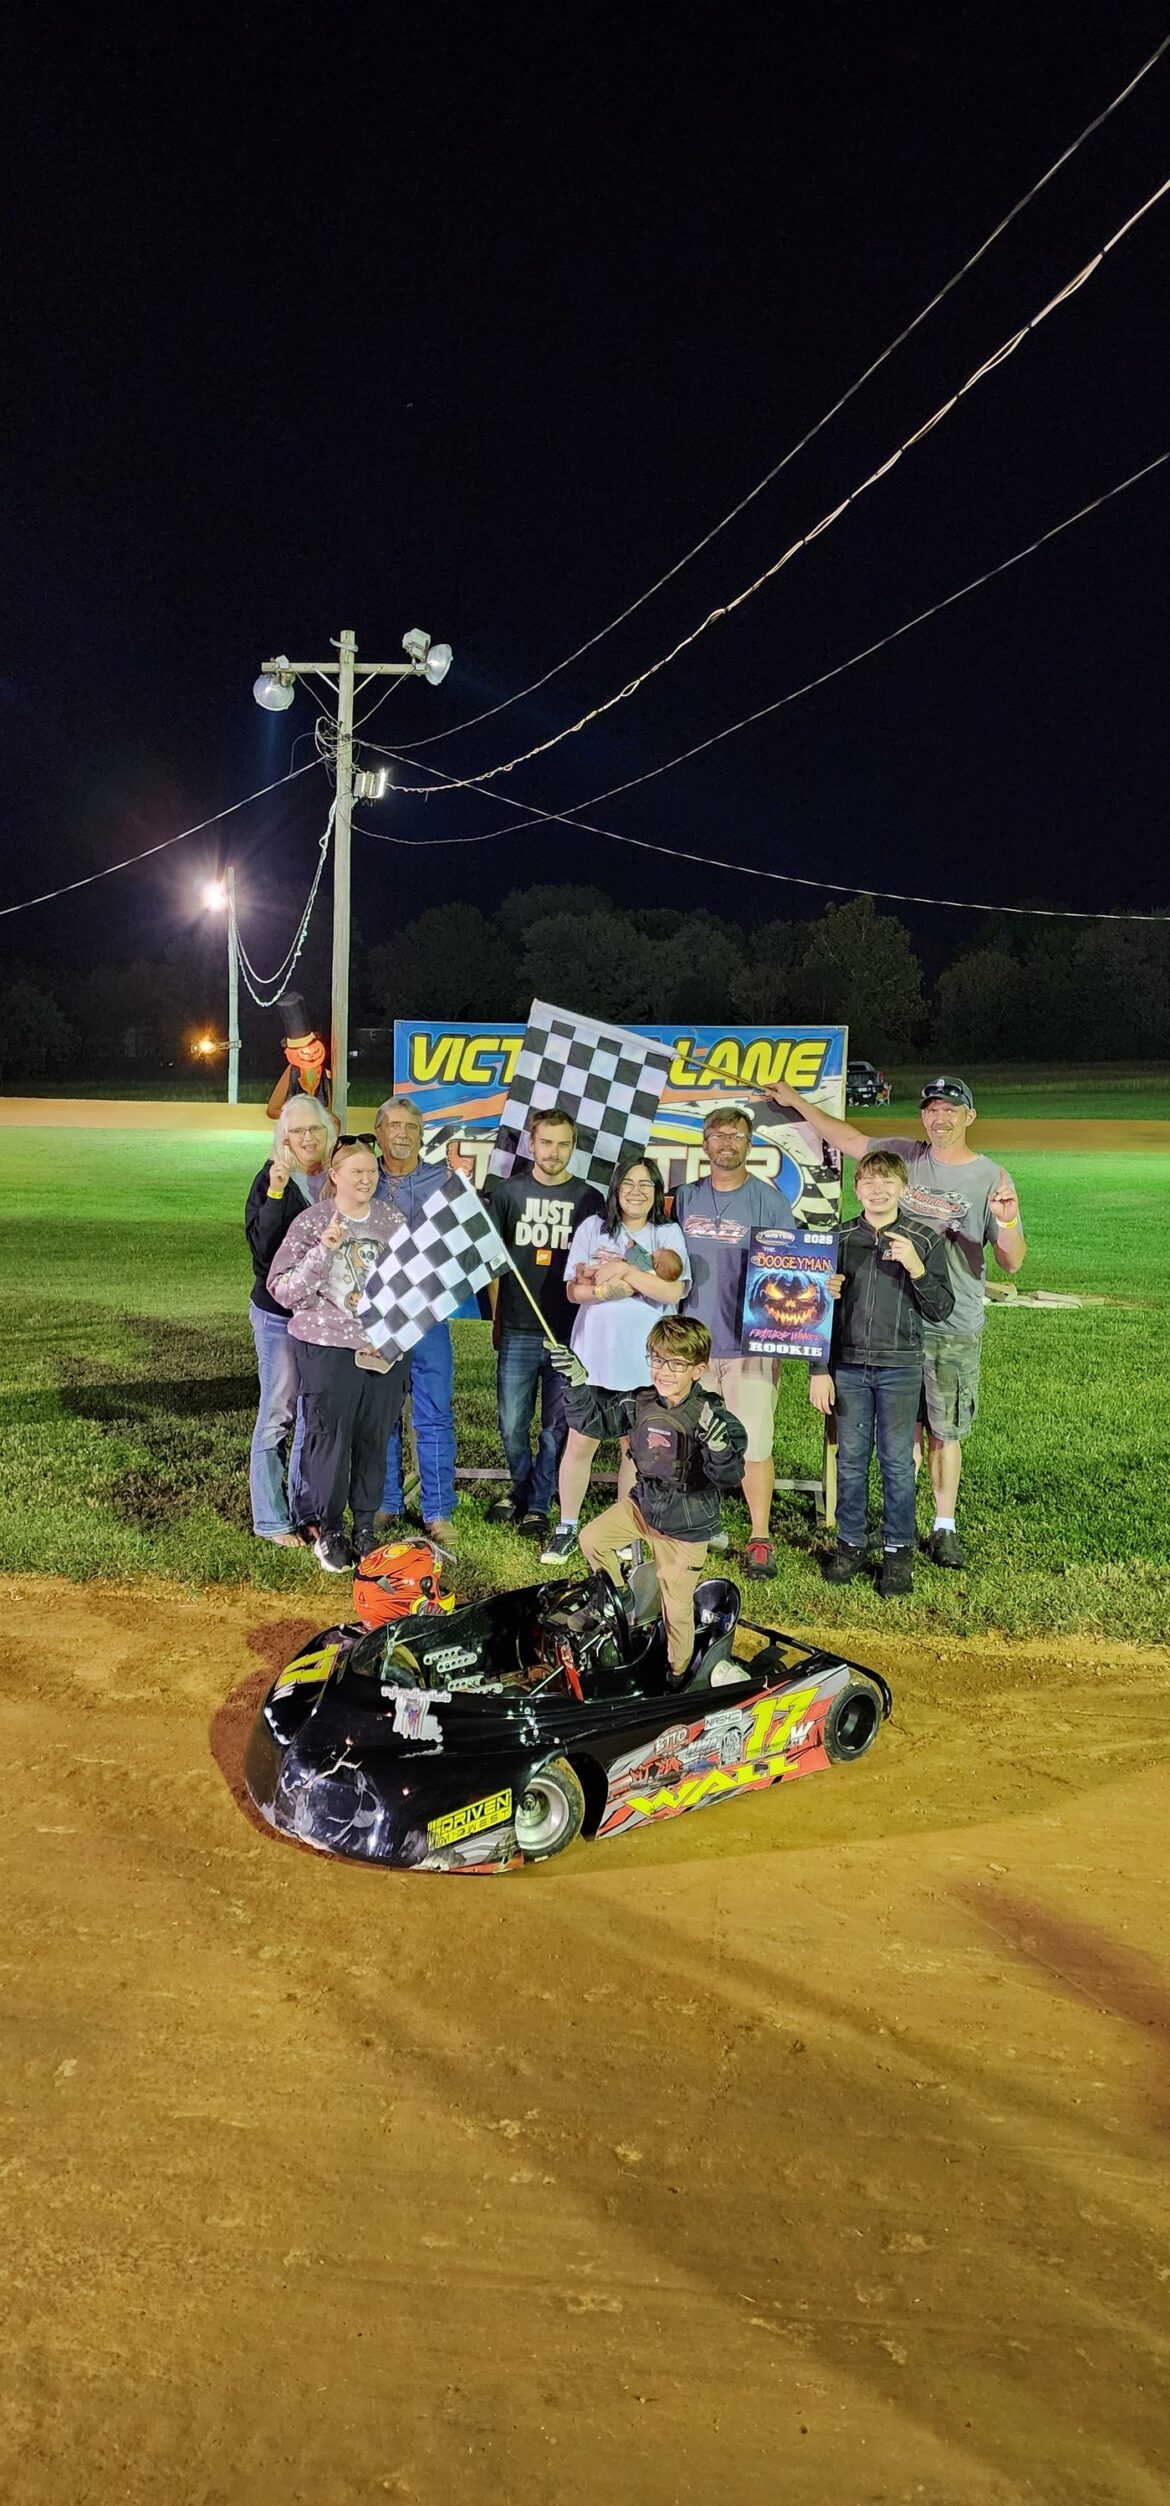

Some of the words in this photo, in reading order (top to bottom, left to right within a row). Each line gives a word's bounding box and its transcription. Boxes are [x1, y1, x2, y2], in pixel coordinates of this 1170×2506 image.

[668, 1039, 829, 1089] LANE
[521, 1197, 575, 1226] JUST
[515, 1221, 549, 1248] DO
[803, 1233, 834, 1245] 2025
[757, 1251, 833, 1272] BOOGEYMAN
[748, 1341, 823, 1357] ROOKIE
[706, 1713, 732, 1727] NASH
[744, 1686, 821, 1761] 17
[624, 1755, 799, 1817] WALL
[441, 1793, 509, 1831] DRIVEN
[440, 1810, 507, 1845] MIDWEST
